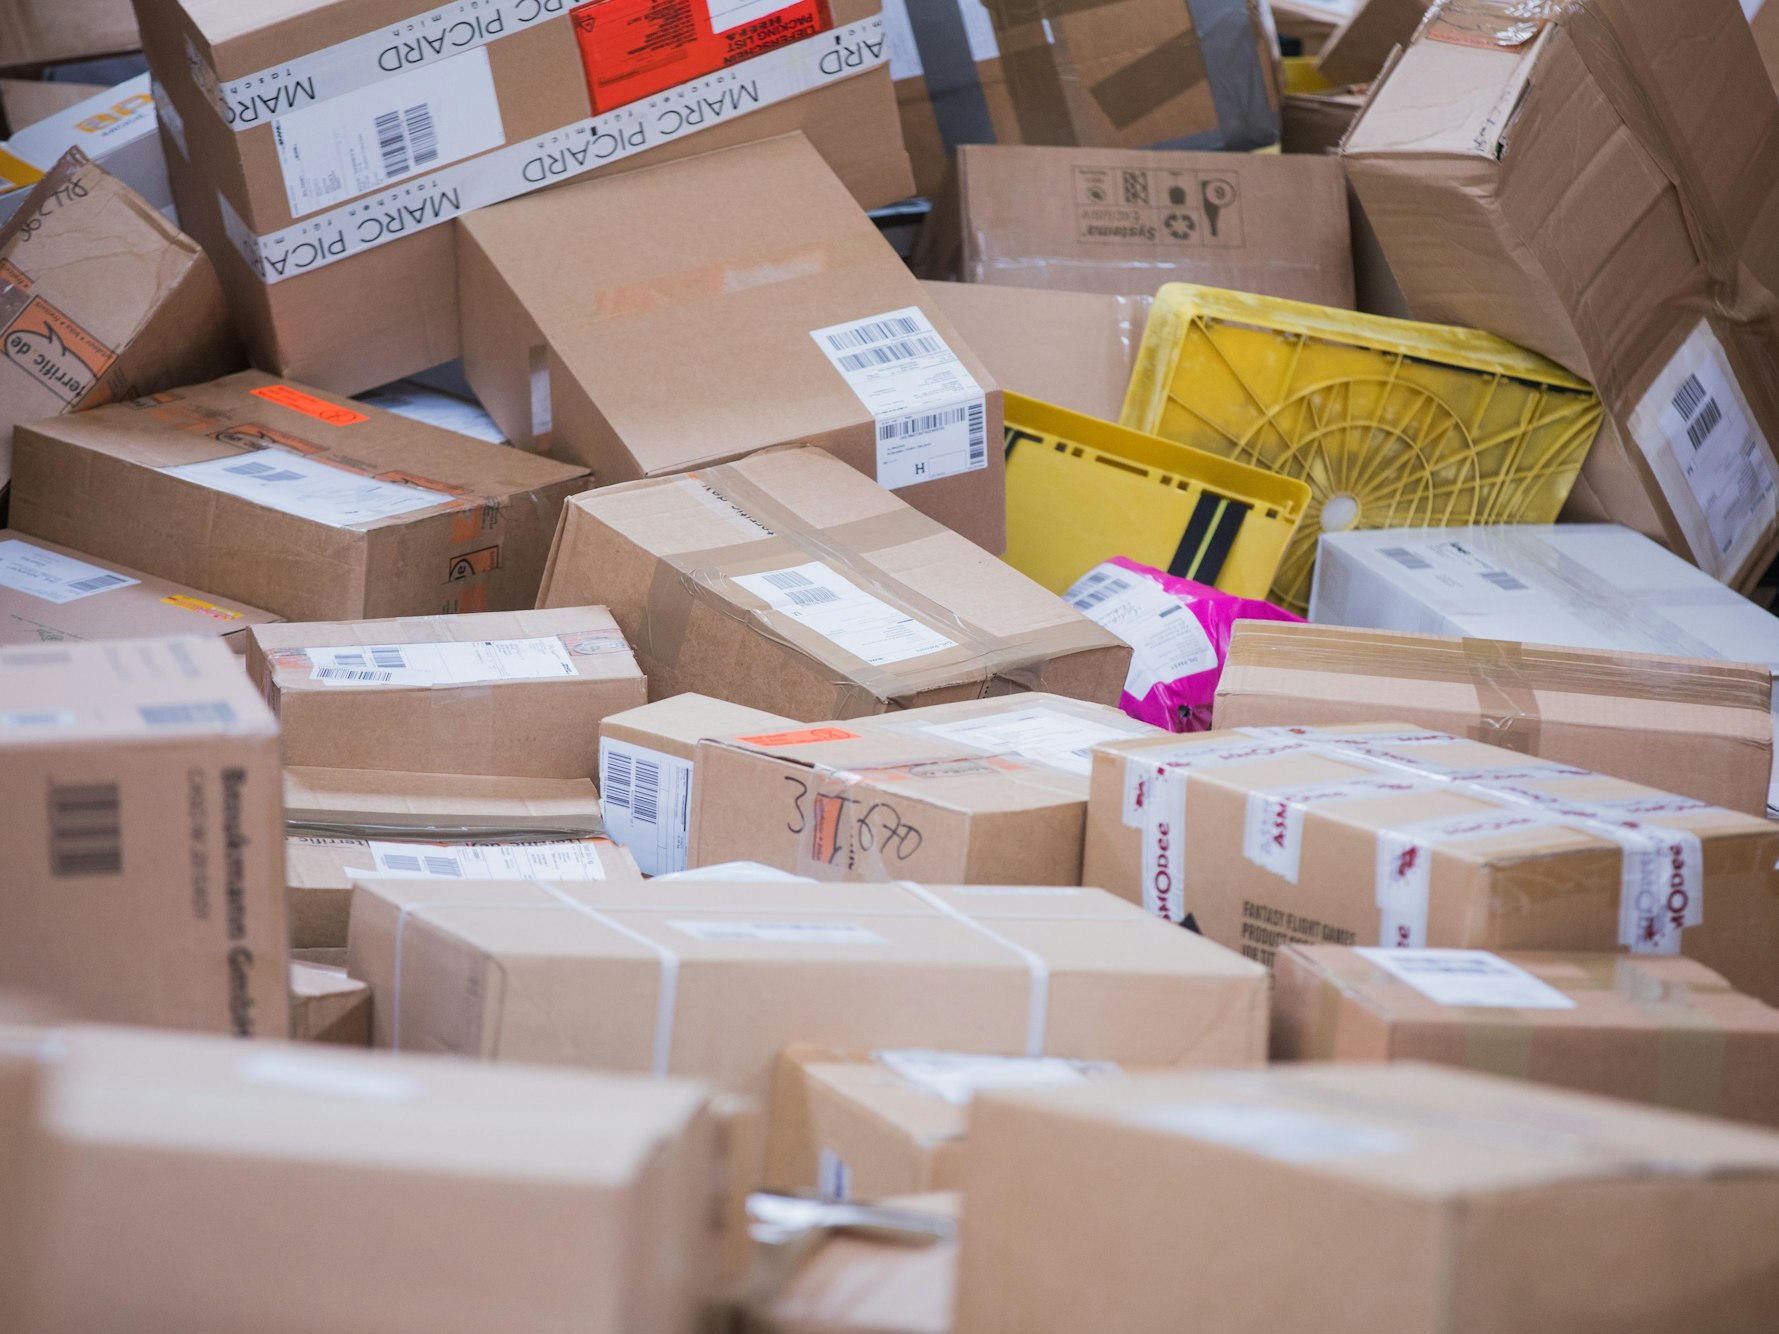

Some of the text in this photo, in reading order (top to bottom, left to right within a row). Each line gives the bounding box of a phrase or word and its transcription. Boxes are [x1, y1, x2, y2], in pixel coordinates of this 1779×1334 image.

[378, 8, 505, 72] PICARD
[727, 35, 755, 53] LIST
[756, 12, 814, 42] PACKING
[819, 32, 886, 76] ARD
[649, 72, 737, 109] Taschen
[522, 79, 760, 183] MARC PICARD
[349, 179, 439, 217] Taschen
[264, 187, 461, 275] MARC PICA
[915, 462, 926, 476] H
[298, 837, 366, 848] terrific
[1241, 922, 1287, 947] PRODUCT
[1242, 900, 1357, 945] FANTASY FLIGHT GAMES
